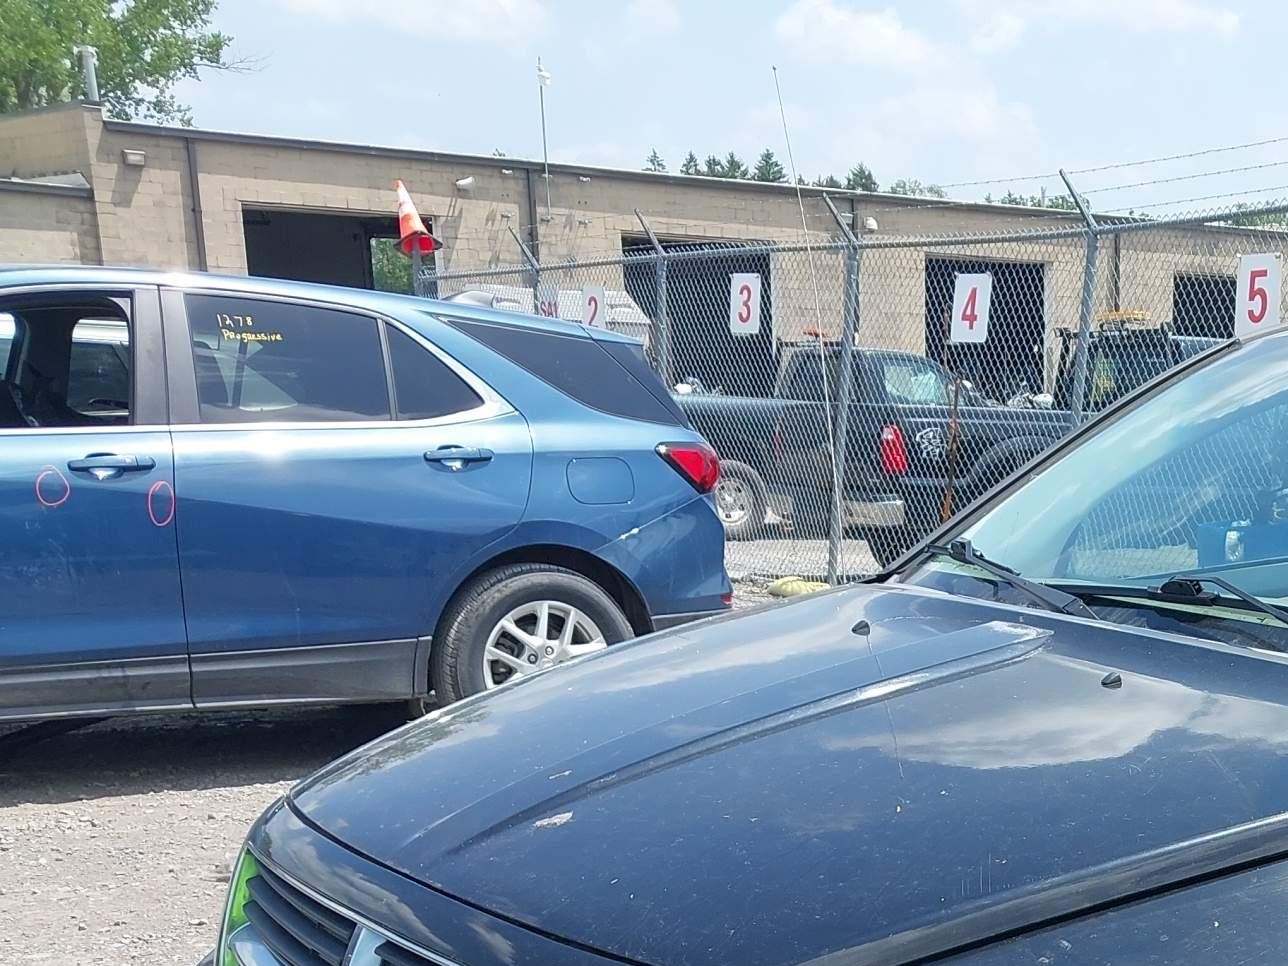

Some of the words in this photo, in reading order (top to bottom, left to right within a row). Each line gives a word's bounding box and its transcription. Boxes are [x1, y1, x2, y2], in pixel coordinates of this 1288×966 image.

[588, 296, 599, 327] 2
[737, 284, 752, 323] 3
[960, 286, 978, 330] 4
[1246, 268, 1269, 324] 5
[216, 313, 253, 328] 1278
